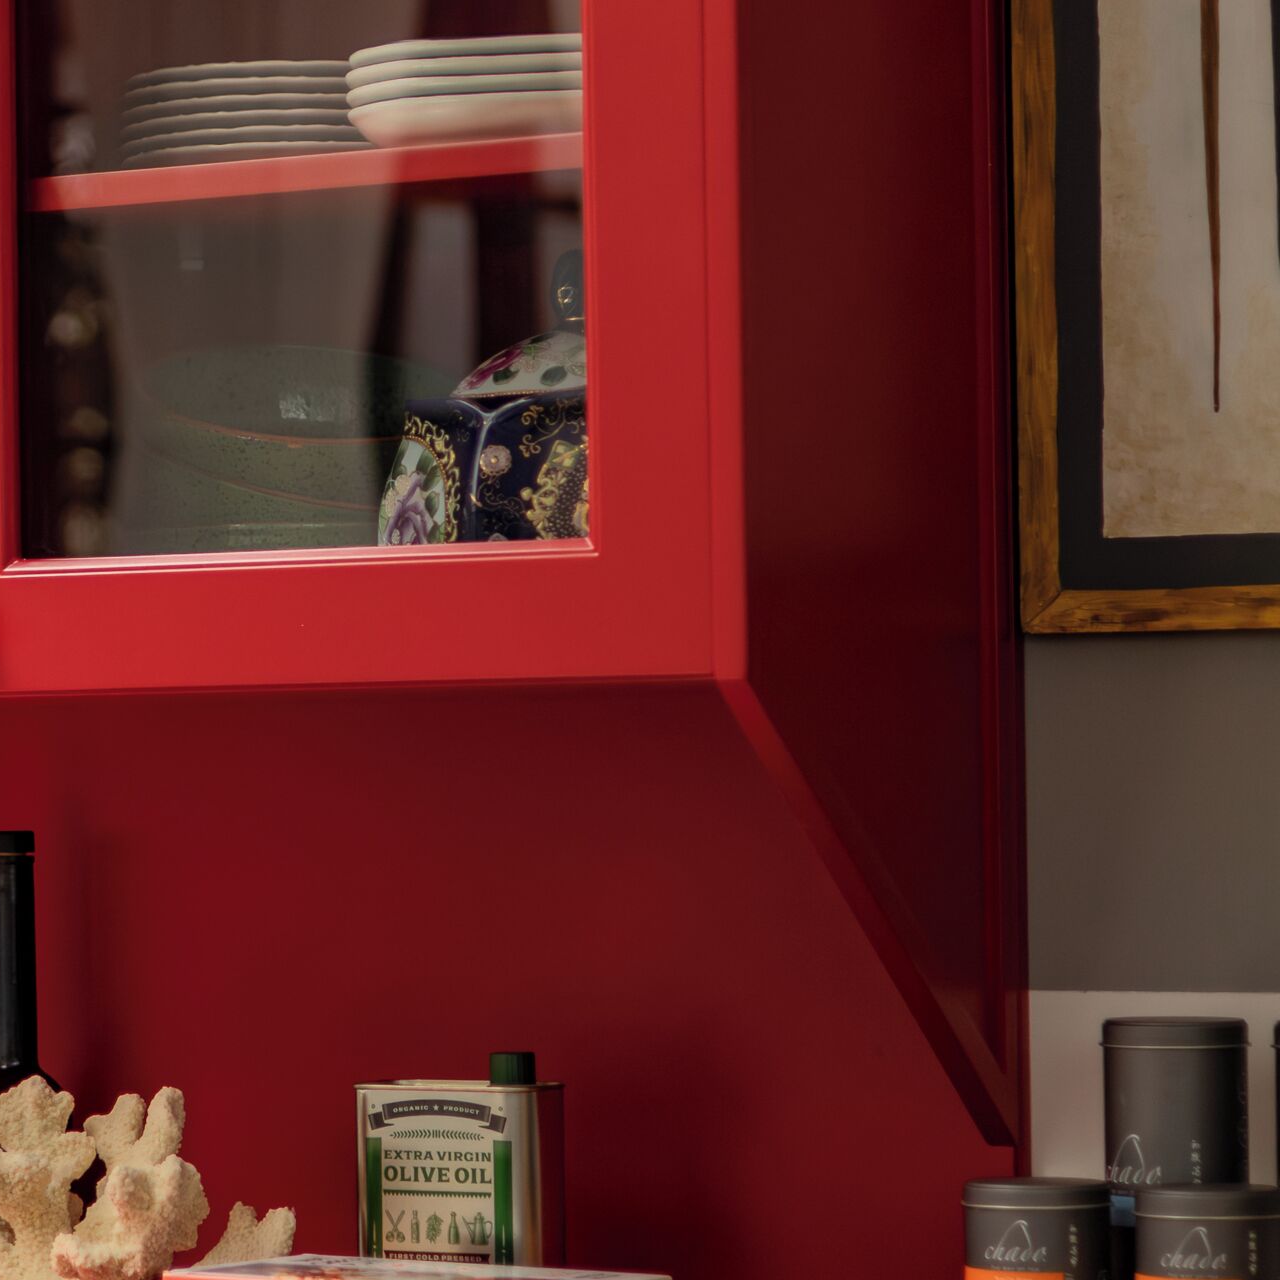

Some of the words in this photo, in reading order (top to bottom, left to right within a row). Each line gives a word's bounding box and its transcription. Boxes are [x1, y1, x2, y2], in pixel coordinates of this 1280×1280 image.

[392, 1105, 429, 1114] ORGANIC
[443, 1106, 480, 1115] PRODUCT
[383, 1149, 434, 1161] EXTRA
[436, 1151, 492, 1163] VIRGIN
[383, 1165, 451, 1183] OLIVE
[454, 1166, 492, 1185] OIL
[388, 1252, 415, 1261] FIRST
[415, 1253, 440, 1262] COLD
[441, 1254, 483, 1263] PRESSED
